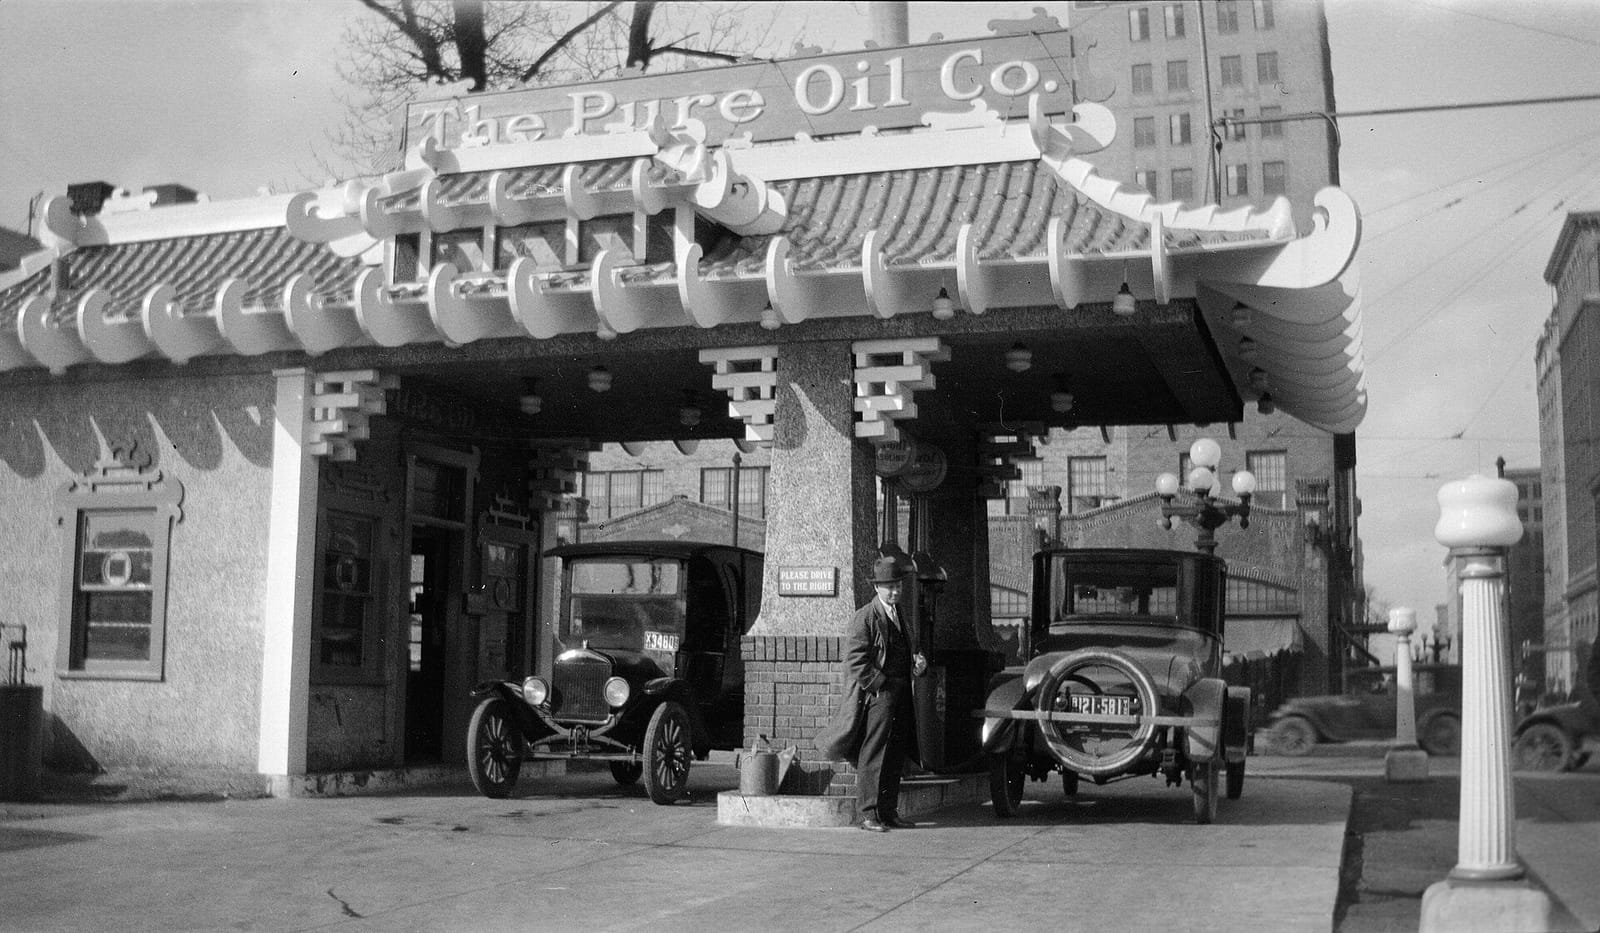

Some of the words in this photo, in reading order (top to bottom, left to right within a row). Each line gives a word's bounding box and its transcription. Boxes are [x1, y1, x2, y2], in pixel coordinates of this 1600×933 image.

[420, 103, 546, 148] The
[567, 89, 767, 135] Pure
[795, 56, 911, 116] Oil
[940, 48, 1058, 100] Co.
[780, 570, 809, 580] PLEASE
[810, 570, 833, 580] DRIVE
[781, 582, 791, 591] TO
[793, 582, 808, 591] THE
[809, 582, 832, 591] RIGHT
